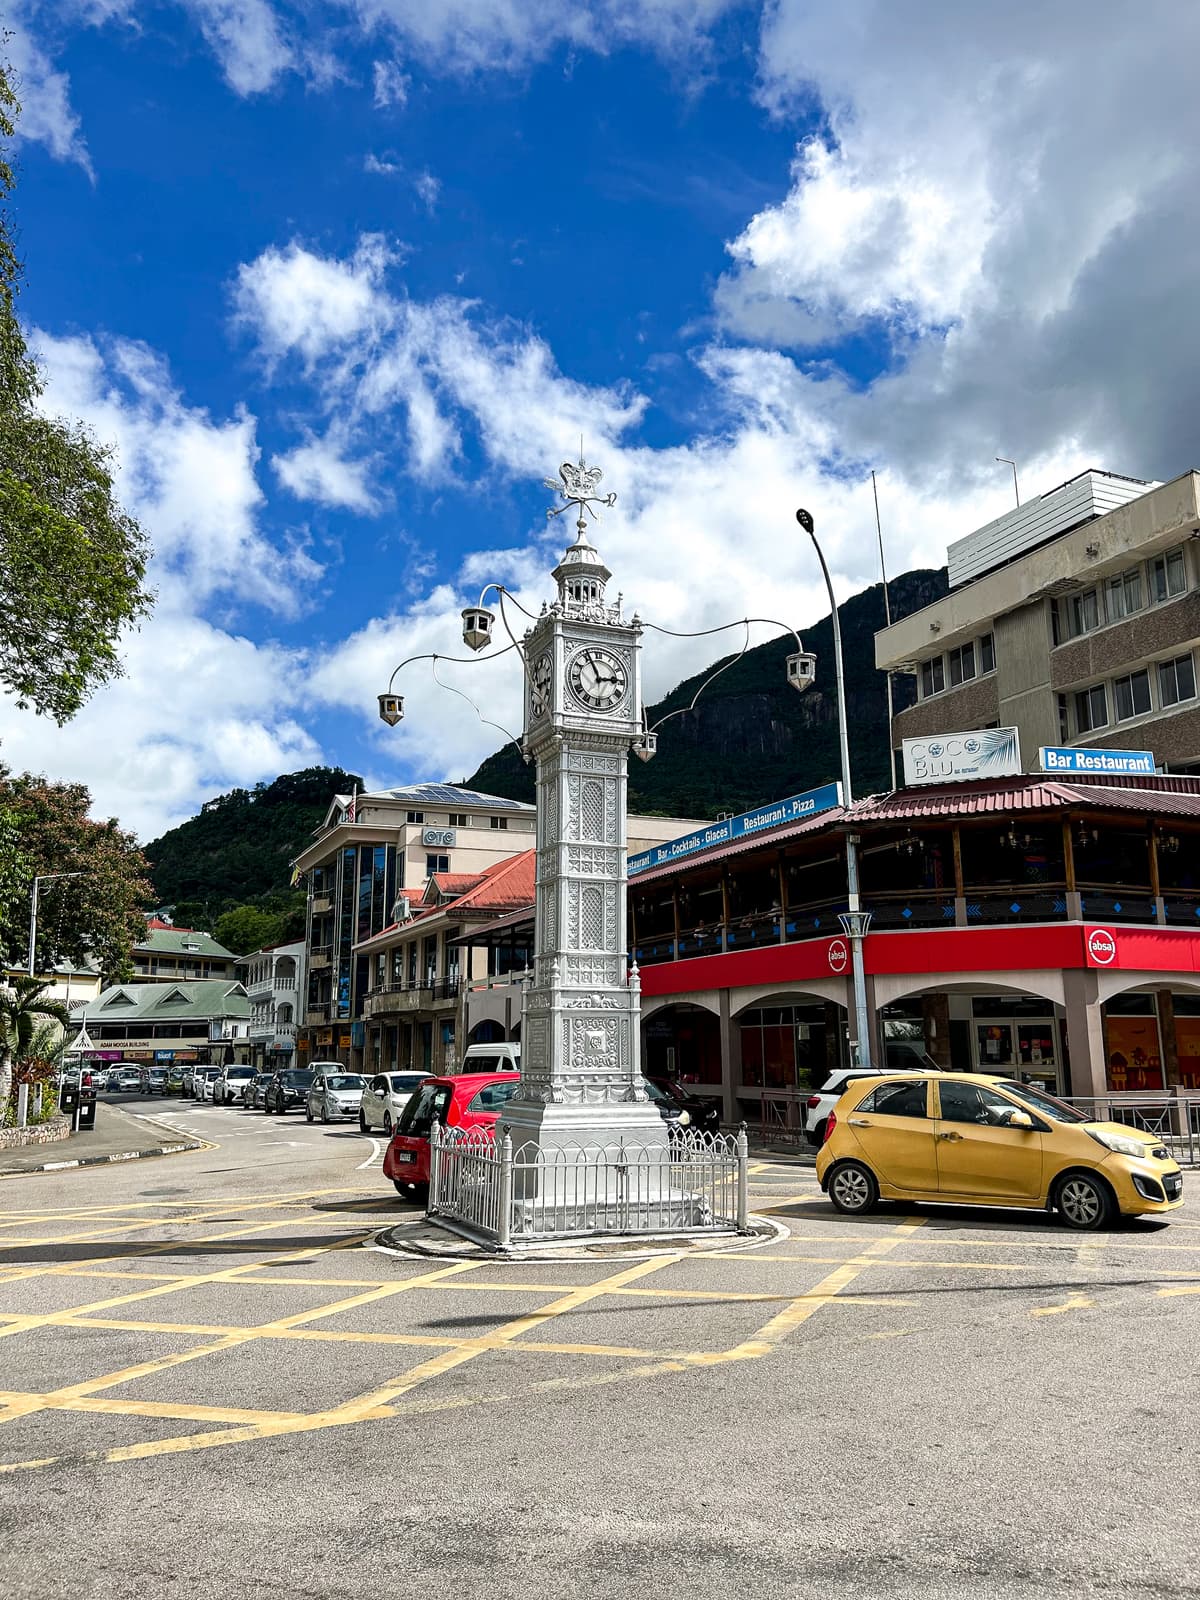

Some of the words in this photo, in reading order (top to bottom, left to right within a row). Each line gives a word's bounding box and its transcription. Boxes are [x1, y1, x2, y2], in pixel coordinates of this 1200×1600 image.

[911, 739, 981, 760] COCO
[913, 760, 953, 779] BLU
[1047, 752, 1072, 767] Bar
[1075, 753, 1150, 770] Restaurant
[744, 807, 785, 830] Restaurant
[792, 798, 815, 815] Pizza
[424, 831, 455, 844] OTC
[657, 849, 667, 860] Bar
[672, 836, 701, 855] Cocktails
[705, 827, 728, 843] Glaces
[1092, 940, 1112, 951] absa
[831, 950, 844, 960] absa
